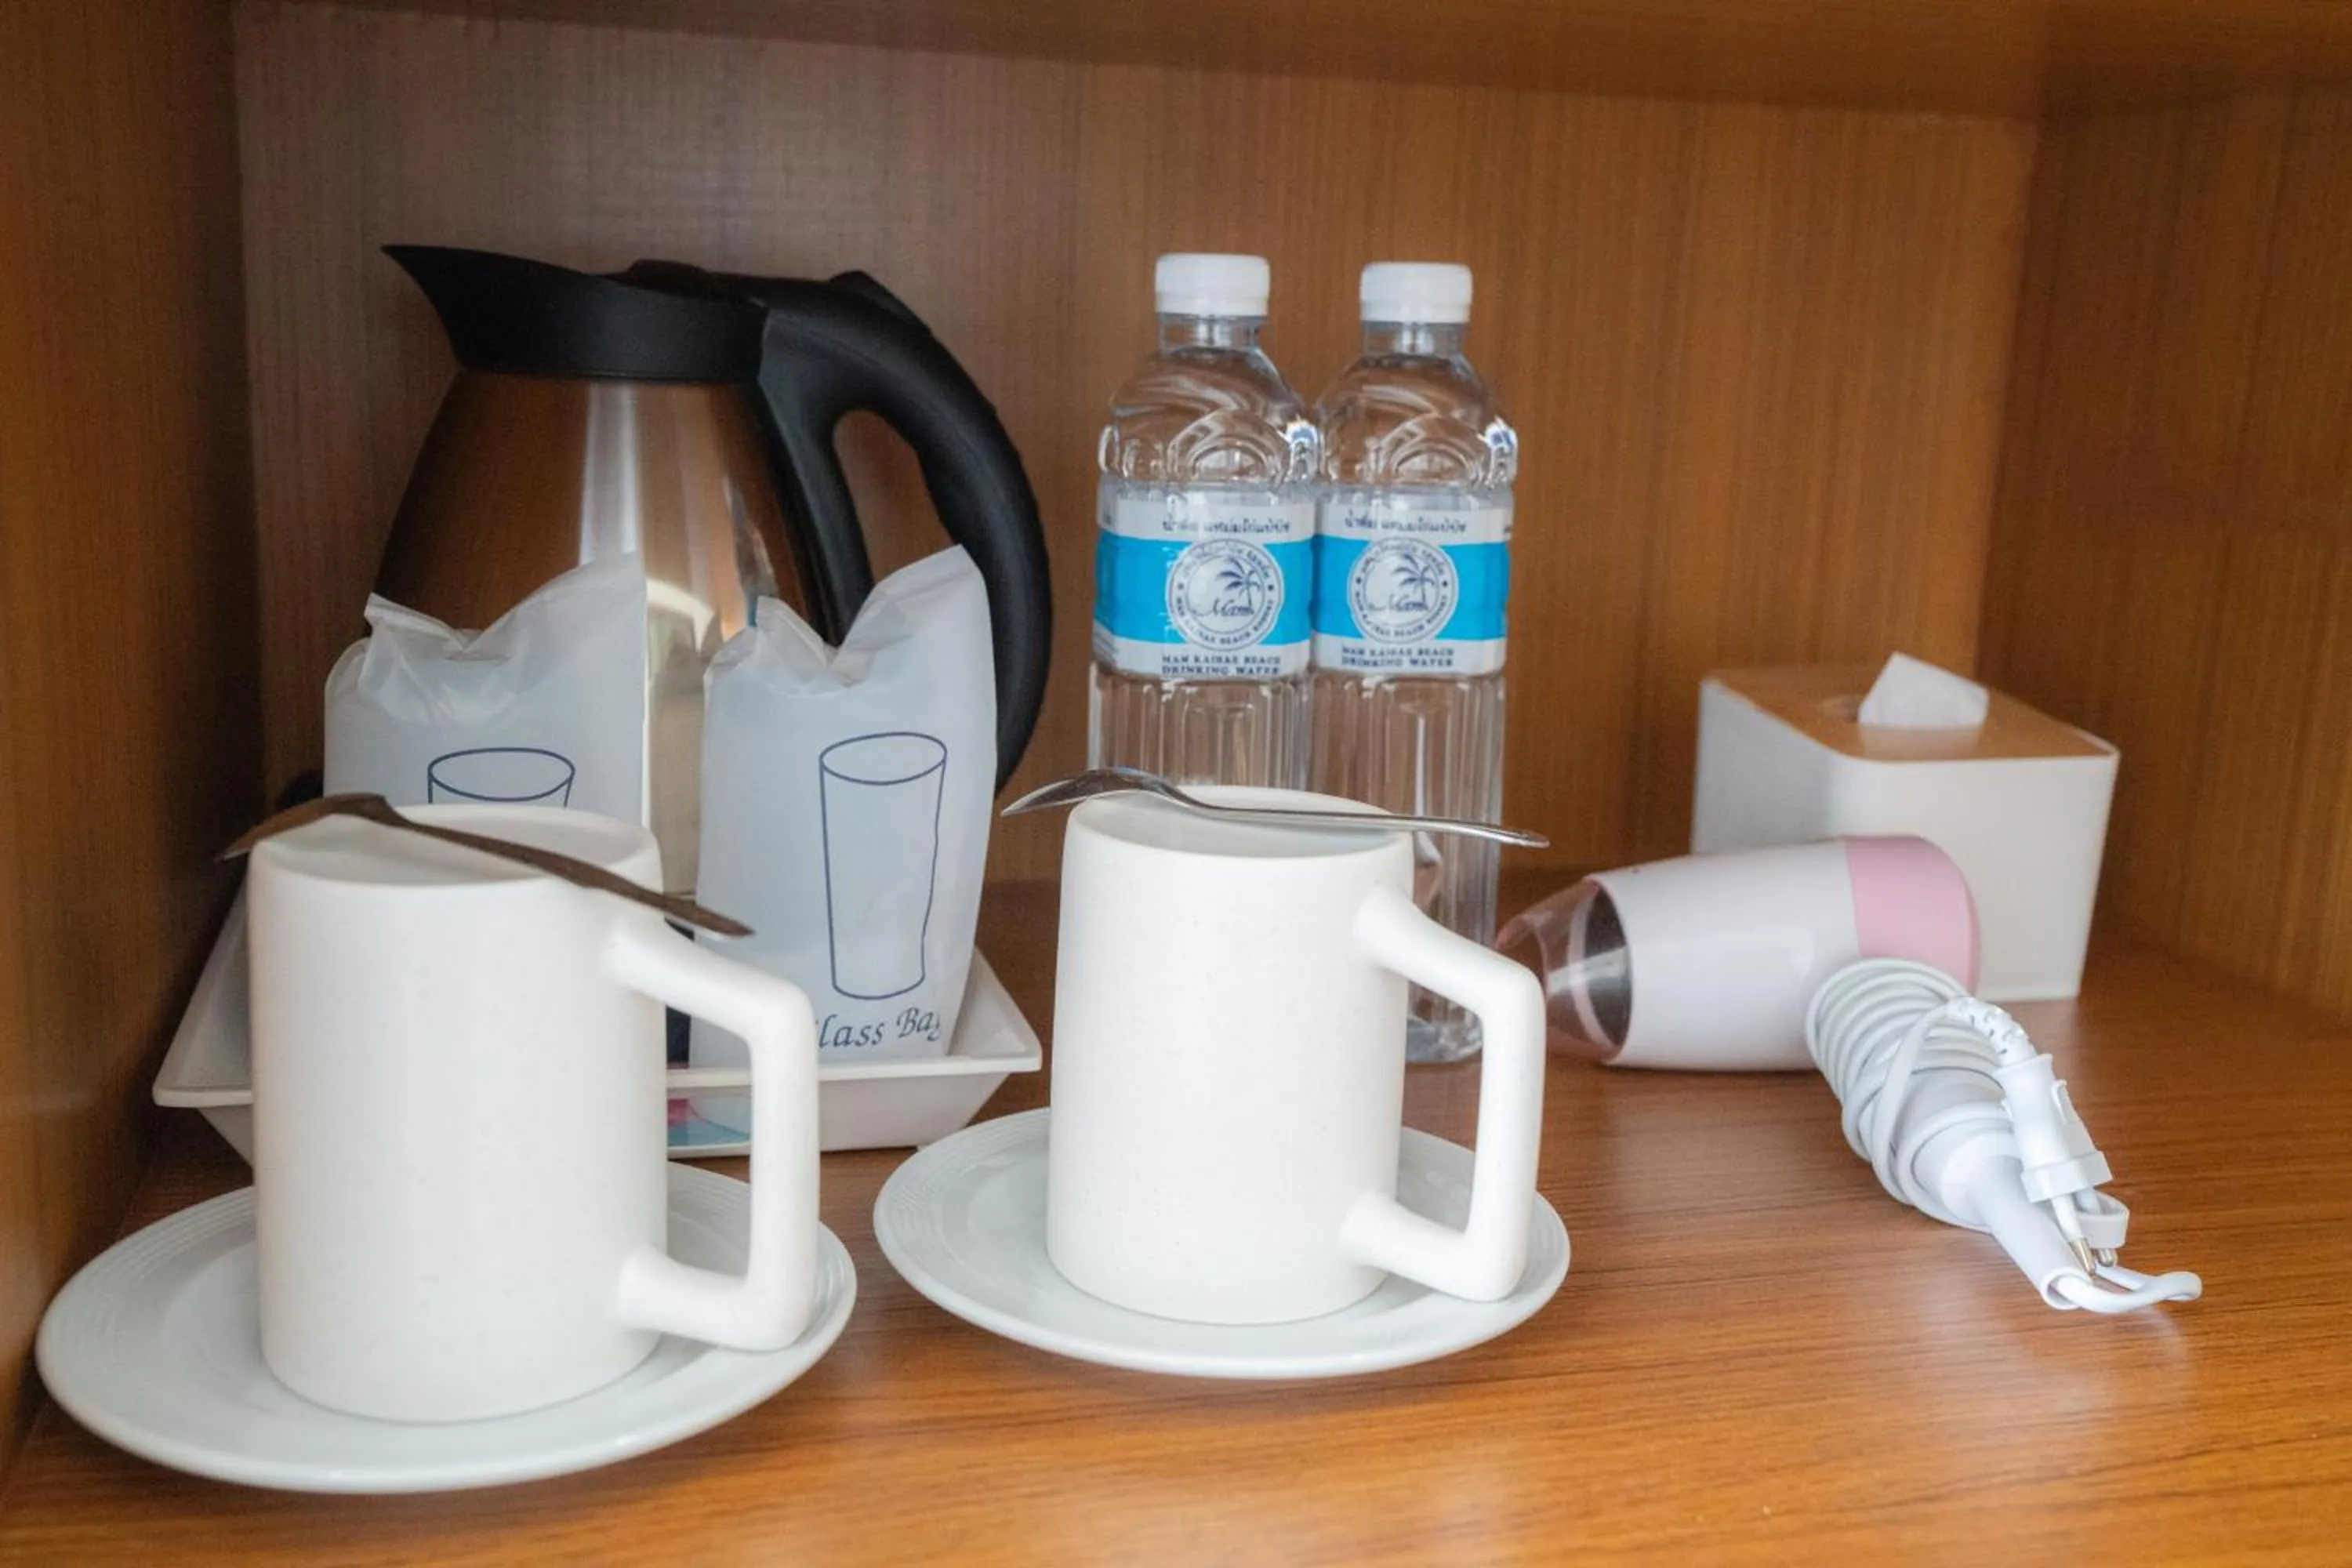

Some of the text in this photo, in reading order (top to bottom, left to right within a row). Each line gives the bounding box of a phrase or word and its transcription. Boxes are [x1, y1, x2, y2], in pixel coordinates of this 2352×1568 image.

[1244, 655, 1281, 665] BEACH
[1410, 658, 1454, 666] WATER
[1161, 666, 1280, 675] DRINKING WATER
[815, 1013, 885, 1048] lass
